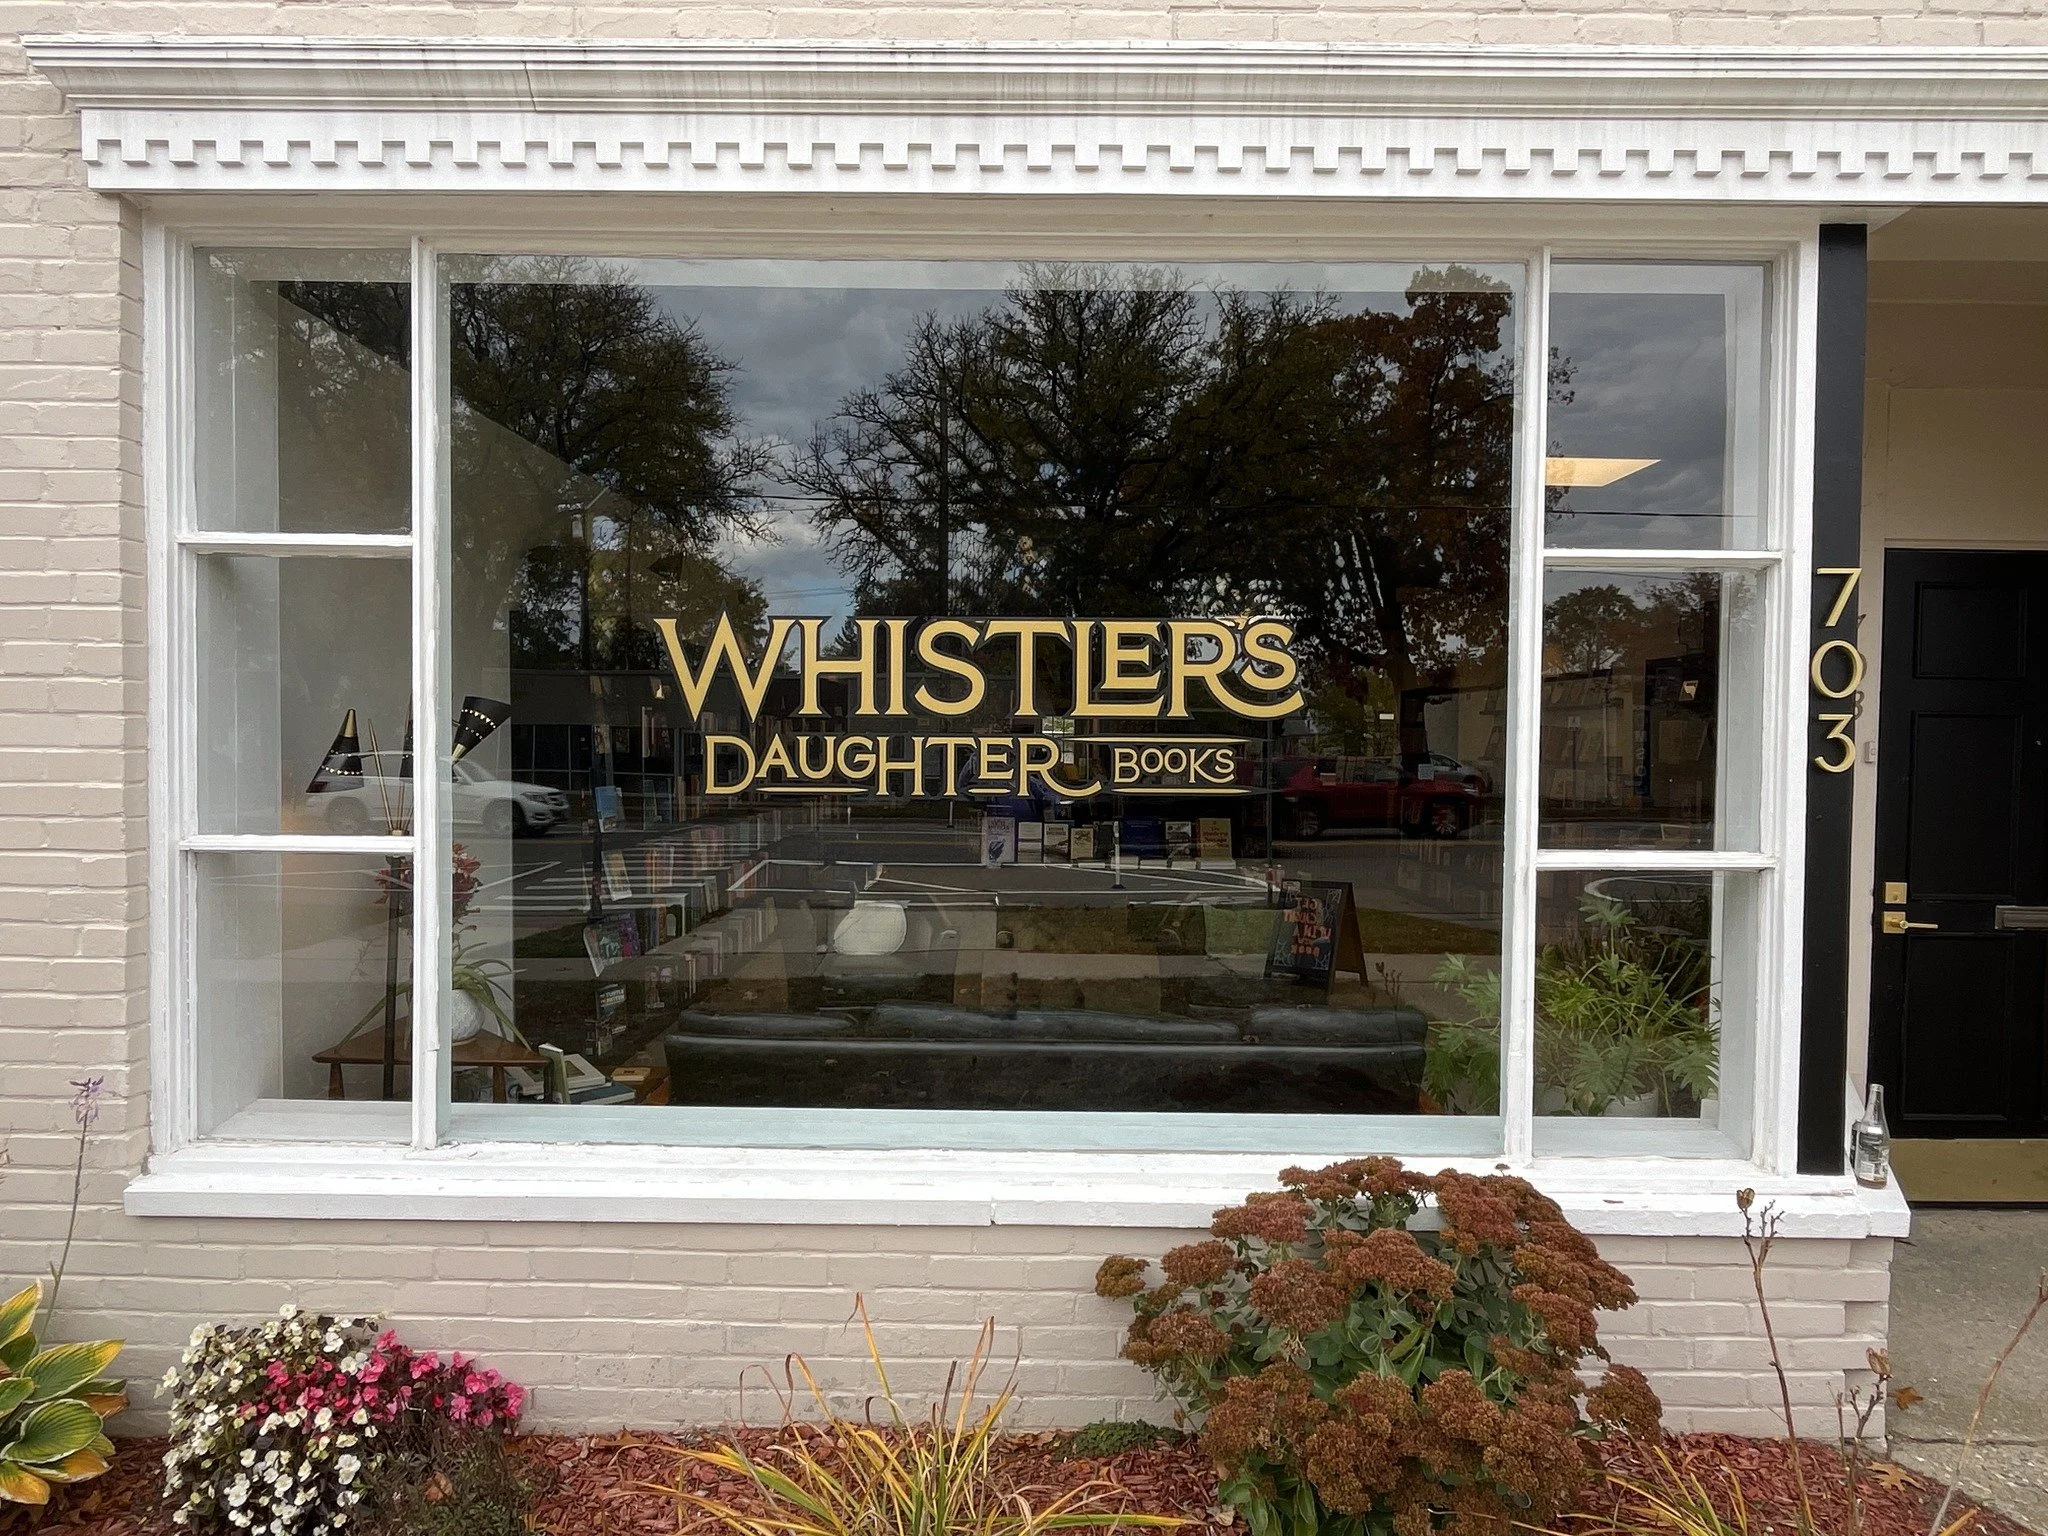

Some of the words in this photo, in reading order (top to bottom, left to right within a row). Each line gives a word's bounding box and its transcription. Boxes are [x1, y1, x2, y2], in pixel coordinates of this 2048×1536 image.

[653, 611, 1305, 723] WHISTLER'S
[1811, 567, 1863, 773] 703
[704, 733, 1102, 797] DAUGHTER
[1114, 748, 1236, 783] BOOKS
